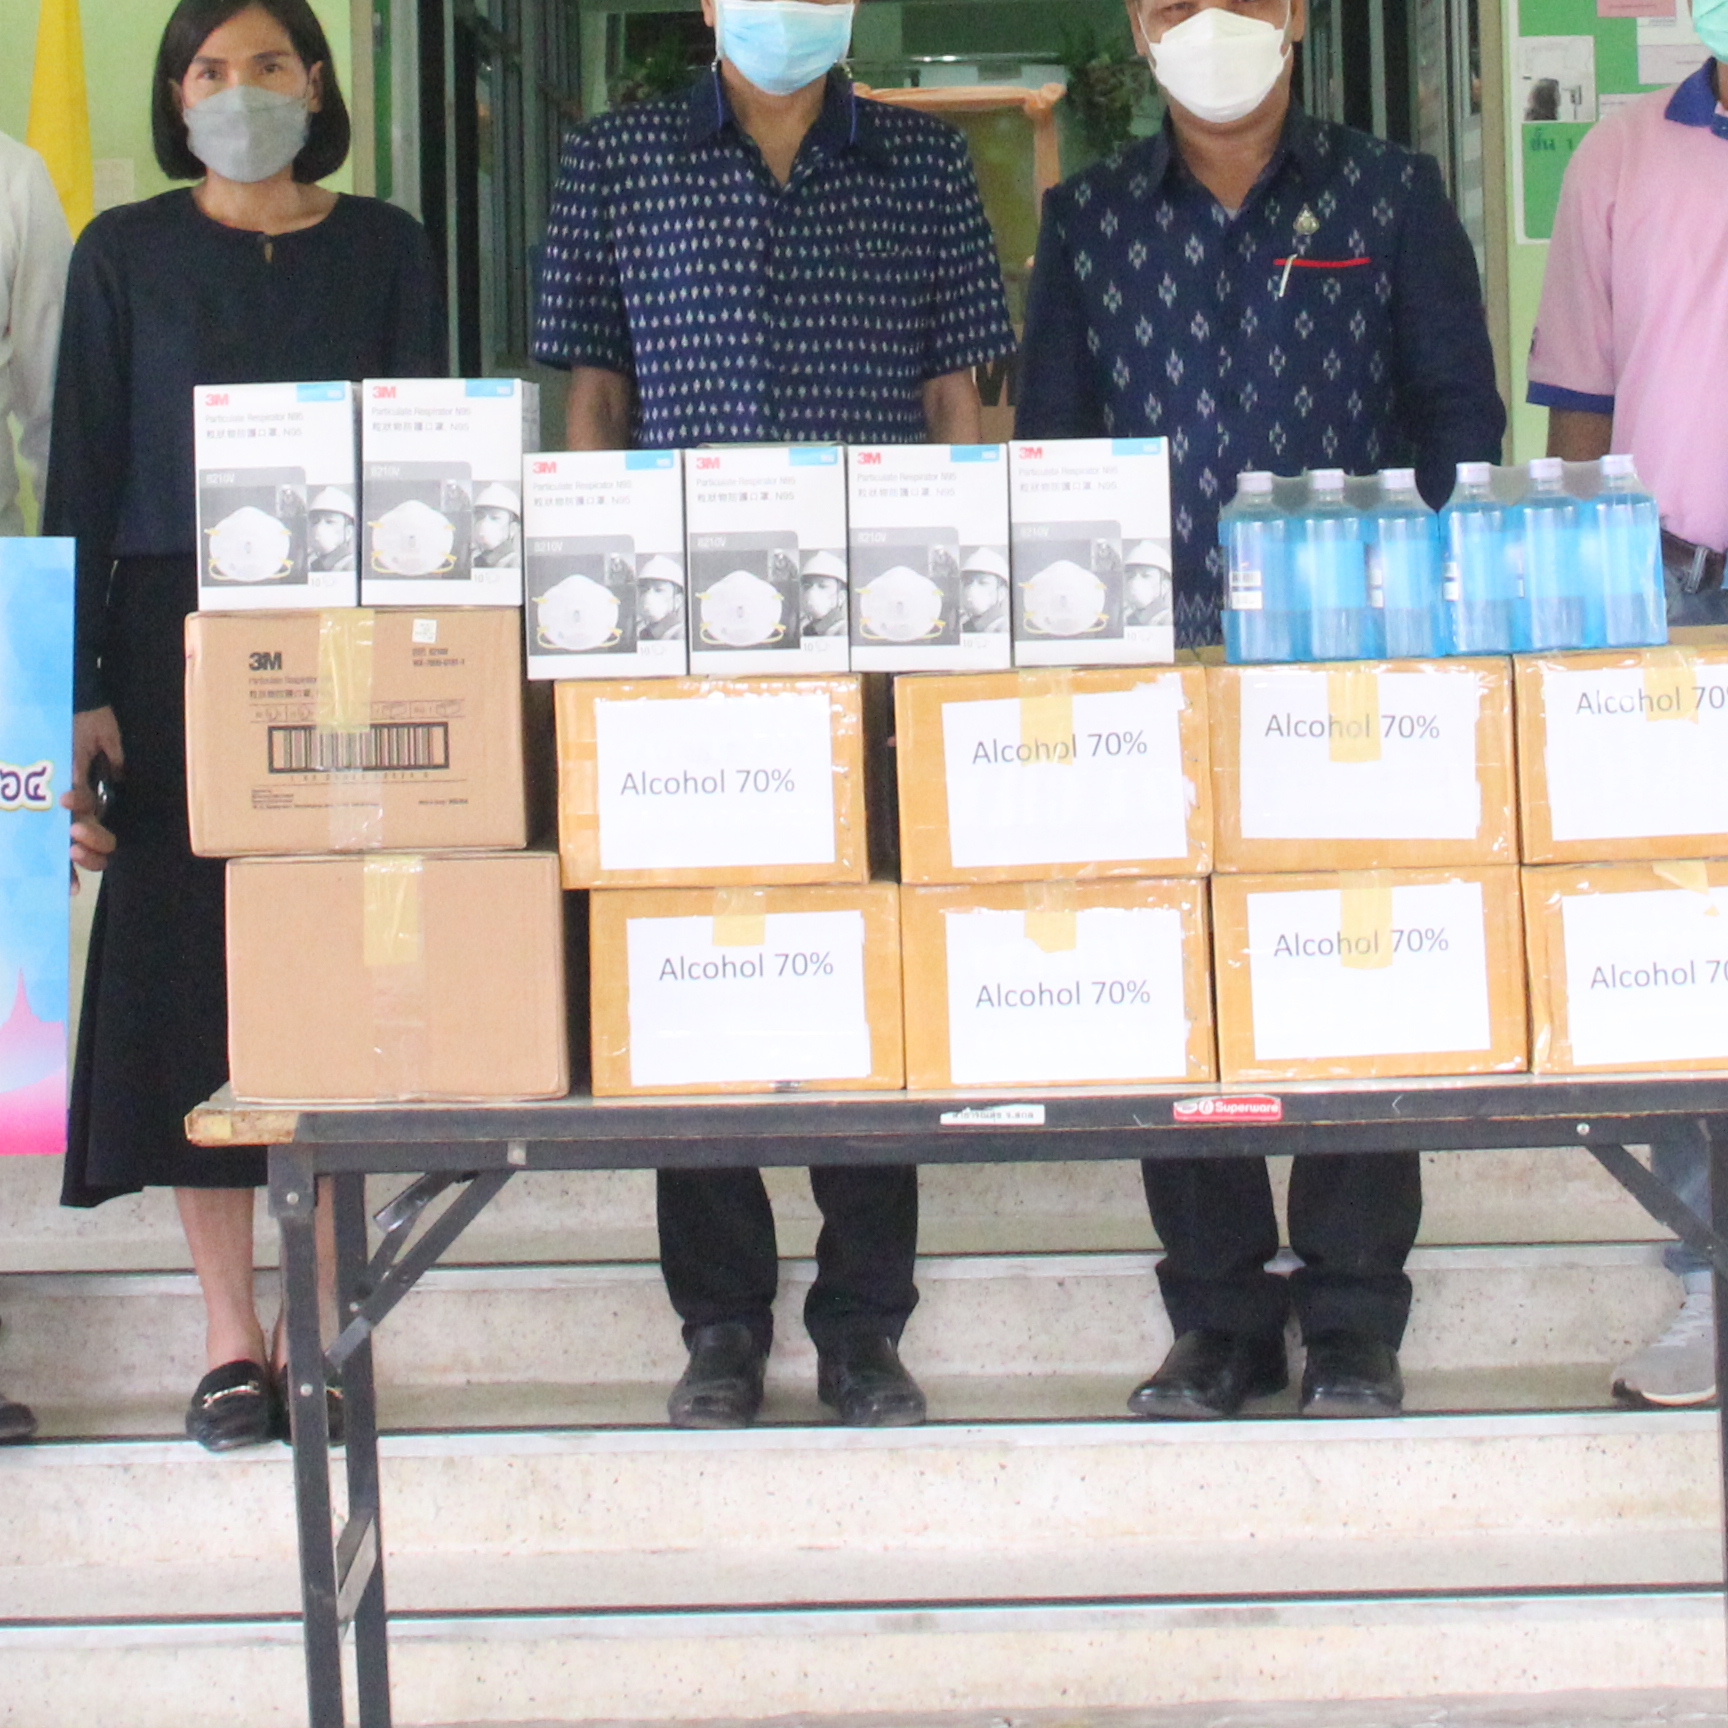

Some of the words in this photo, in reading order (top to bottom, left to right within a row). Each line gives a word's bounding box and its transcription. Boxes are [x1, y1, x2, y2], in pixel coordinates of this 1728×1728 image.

[205, 394, 229, 406] 3M
[373, 386, 396, 399] 3M
[696, 457, 720, 469] 3M
[857, 452, 881, 464] 3M
[1019, 447, 1042, 459] 3M
[533, 461, 557, 474] 3M
[249, 651, 282, 671] 3M
[1575, 687, 1681, 716] Alcohol
[1265, 713, 1370, 740] Alcohol
[1380, 713, 1441, 739] 70%
[972, 734, 1078, 766] Alcohol
[1088, 731, 1148, 758] 70%
[621, 768, 727, 797] Alcohol
[730, 768, 795, 794] 70%
[1273, 929, 1379, 957] Alcohol
[1389, 927, 1449, 953] 70%
[659, 952, 765, 981] Alcohol
[772, 950, 834, 976] 70%
[1591, 959, 1697, 989] Alcohol
[976, 980, 1081, 1008] Alcohol
[1091, 980, 1152, 1006] 70%
[1214, 1101, 1279, 1115] Superware
